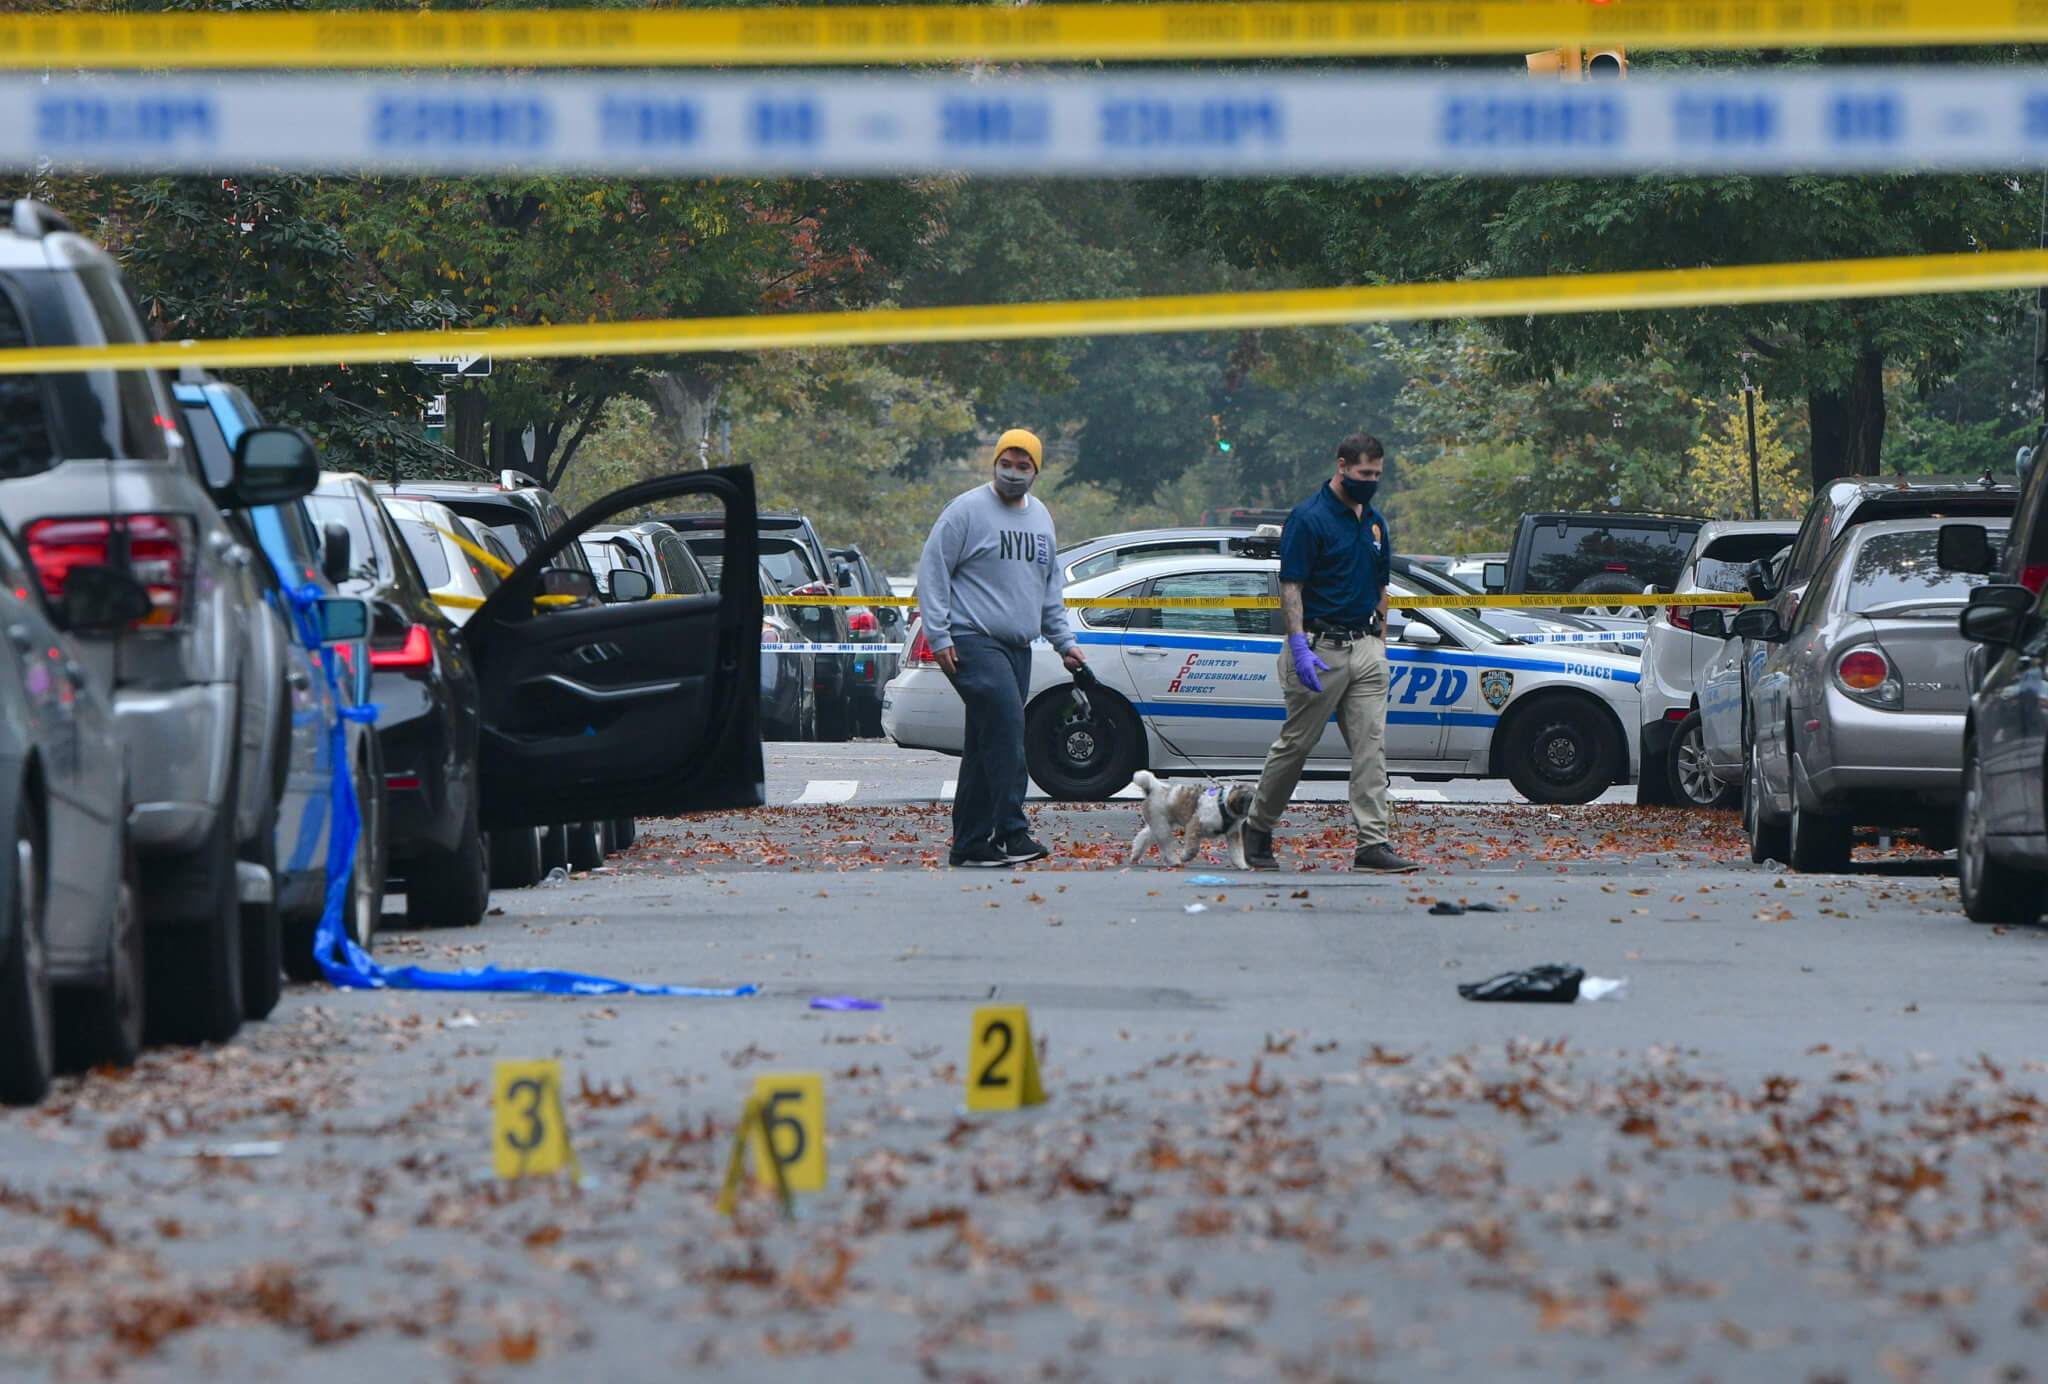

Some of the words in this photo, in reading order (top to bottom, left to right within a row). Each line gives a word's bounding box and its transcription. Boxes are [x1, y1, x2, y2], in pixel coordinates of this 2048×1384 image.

[1000, 530, 1035, 563] NYU
[1186, 653, 1239, 667] COURTESY
[1567, 662, 1612, 680] POLICE
[1167, 679, 1215, 693] RESPECT
[1176, 666, 1267, 682] PROFESSIONALISM
[1388, 665, 1469, 706] YPD
[978, 1020, 1012, 1088] 2
[506, 1079, 544, 1152] 3
